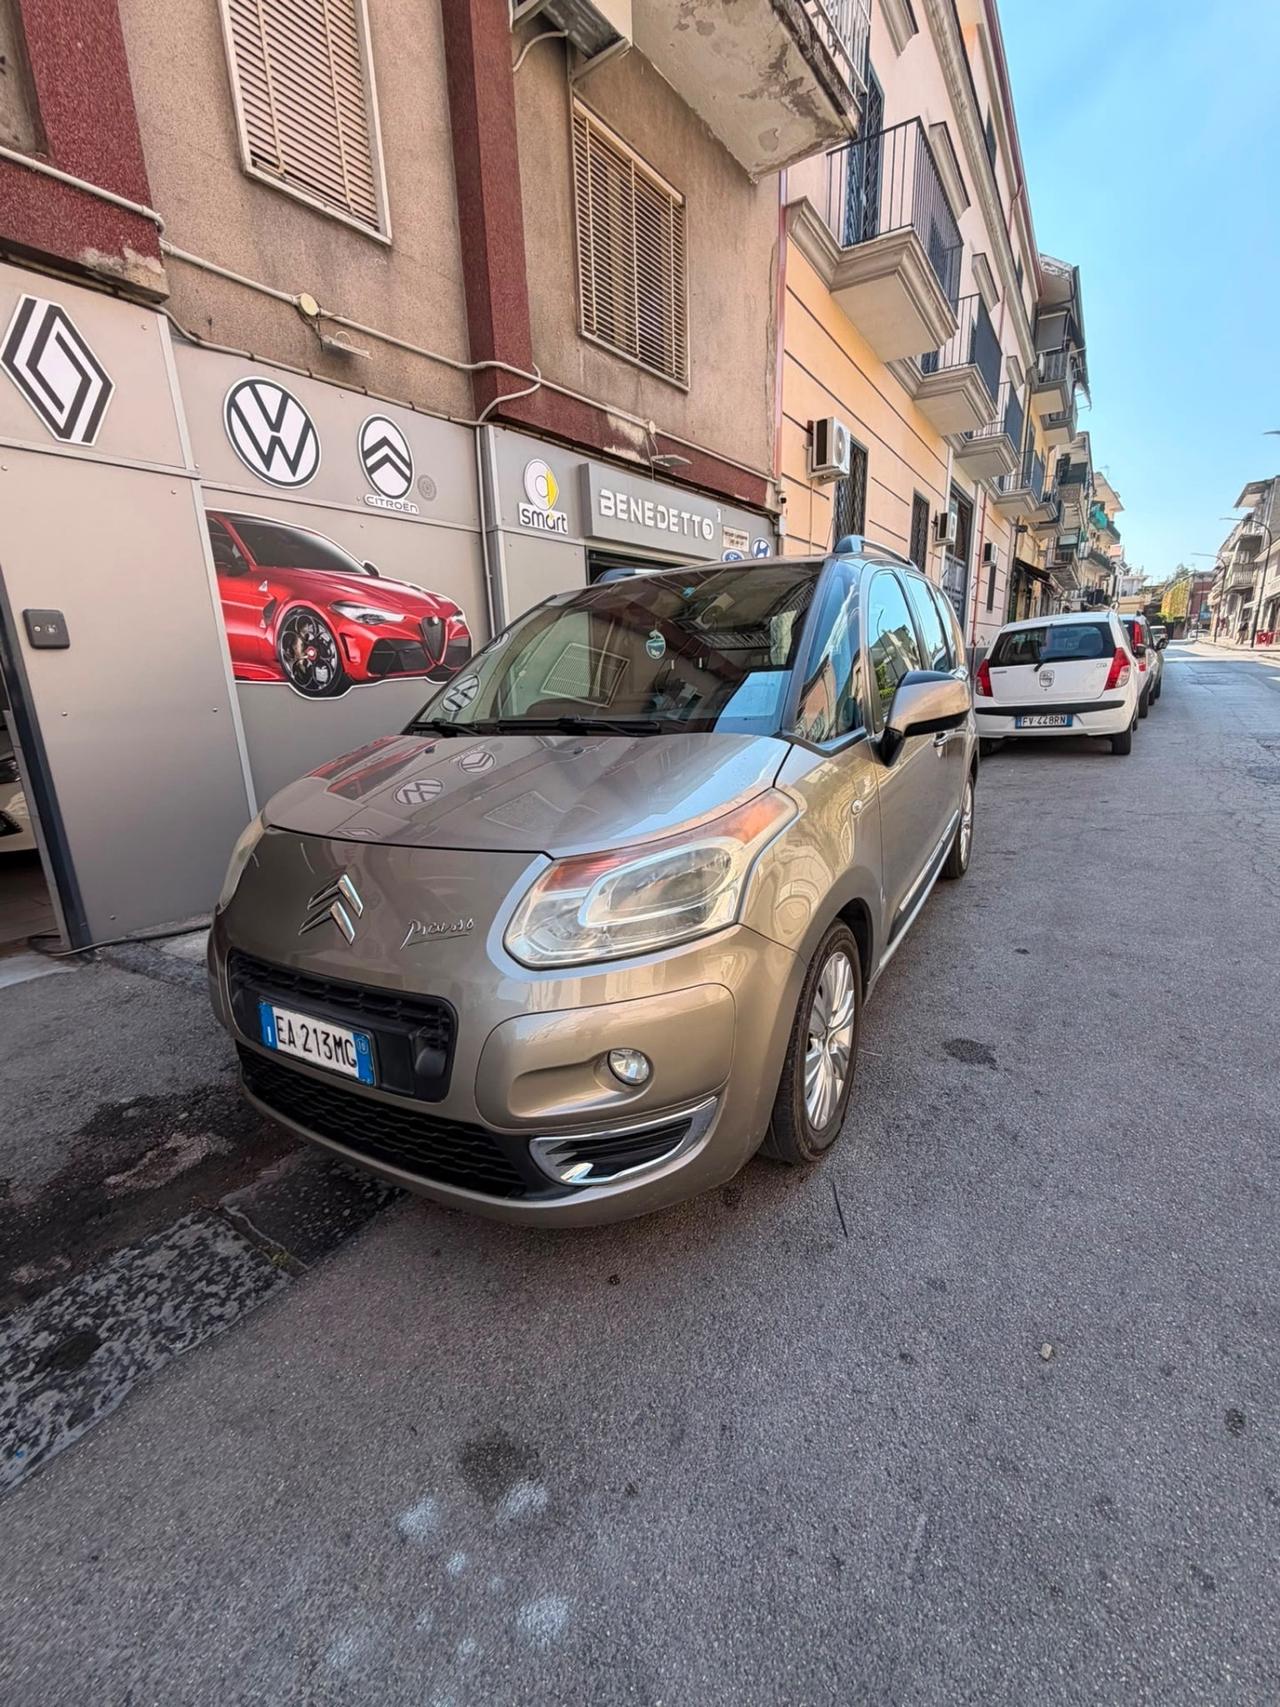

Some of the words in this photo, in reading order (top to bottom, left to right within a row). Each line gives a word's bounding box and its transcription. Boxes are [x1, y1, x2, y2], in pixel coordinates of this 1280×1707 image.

[521, 508, 568, 533] smart
[600, 488, 714, 541] BENEDETTO
[275, 1015, 297, 1049] EA
[300, 1023, 358, 1069] 213MG
